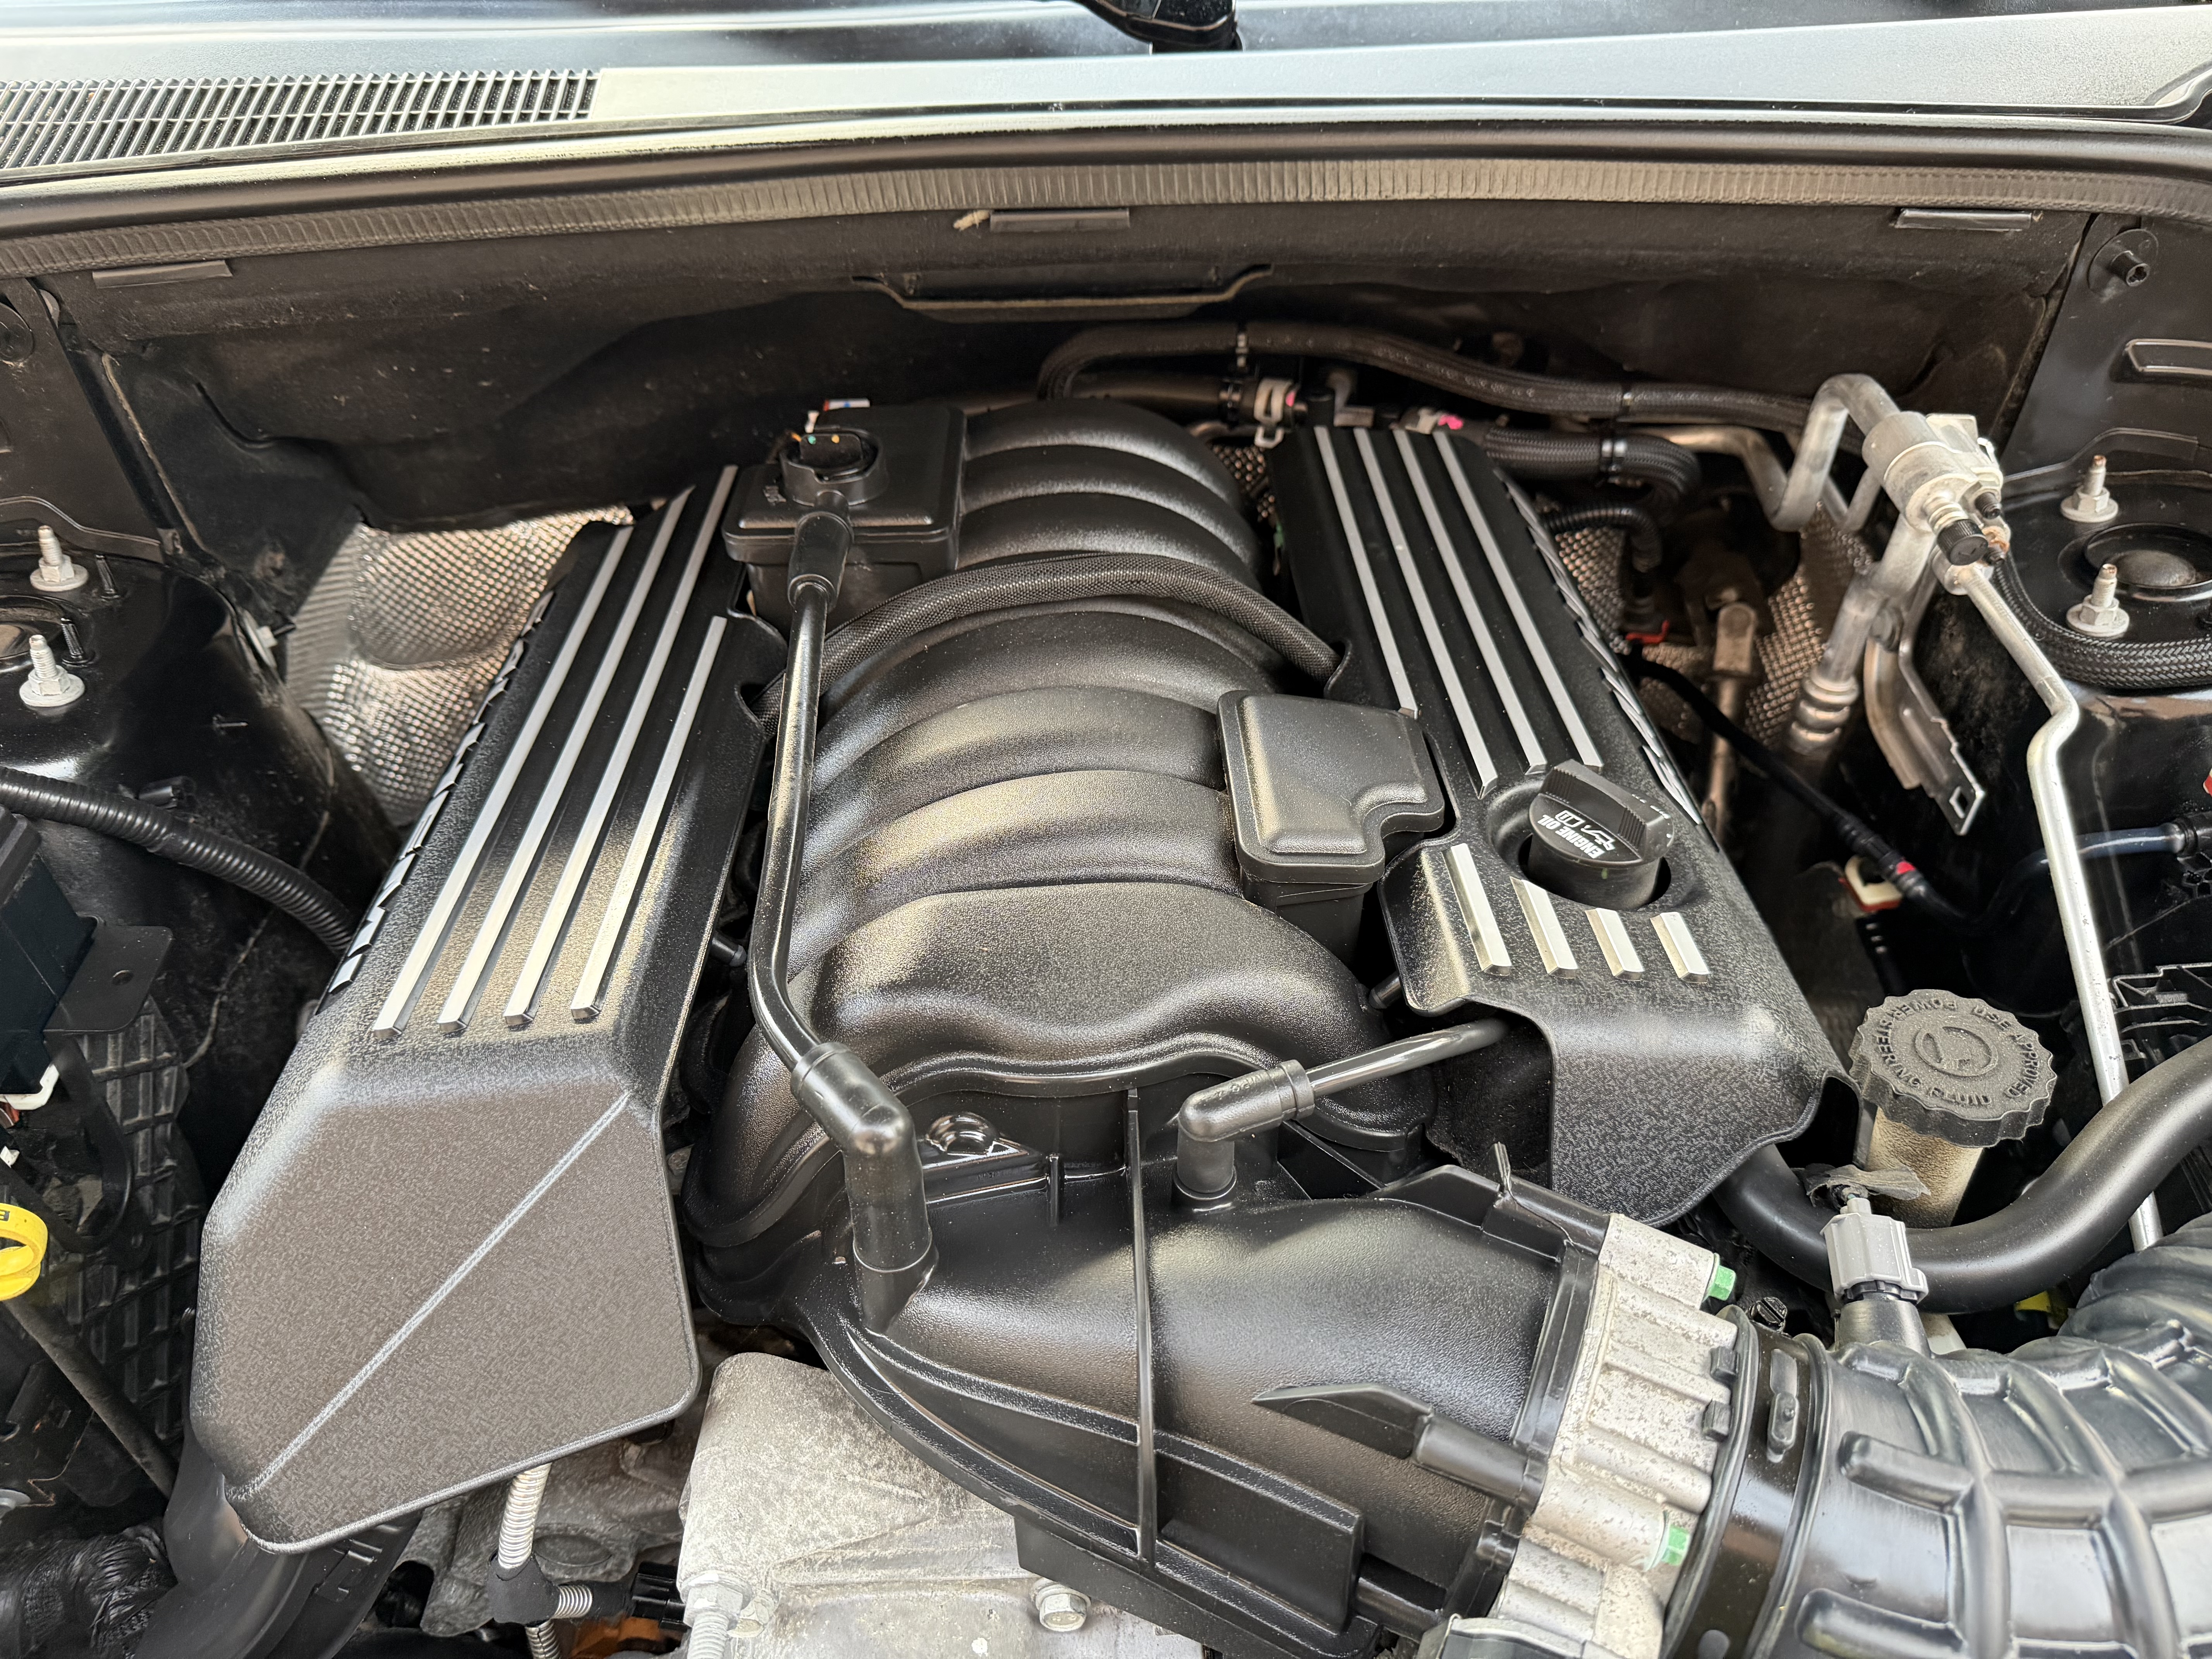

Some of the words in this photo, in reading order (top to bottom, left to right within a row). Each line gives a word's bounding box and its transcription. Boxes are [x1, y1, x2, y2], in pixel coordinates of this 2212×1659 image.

[1537, 814, 1561, 830] OIL
[1555, 826, 1606, 859] ENGINE
[1886, 998, 1957, 1021] POWER
[1876, 1019, 1922, 1086] STEERING
[1973, 1006, 2011, 1028] USE
[2008, 1034, 2039, 1097] APPROVED
[1930, 1087, 1991, 1104] FLUID
